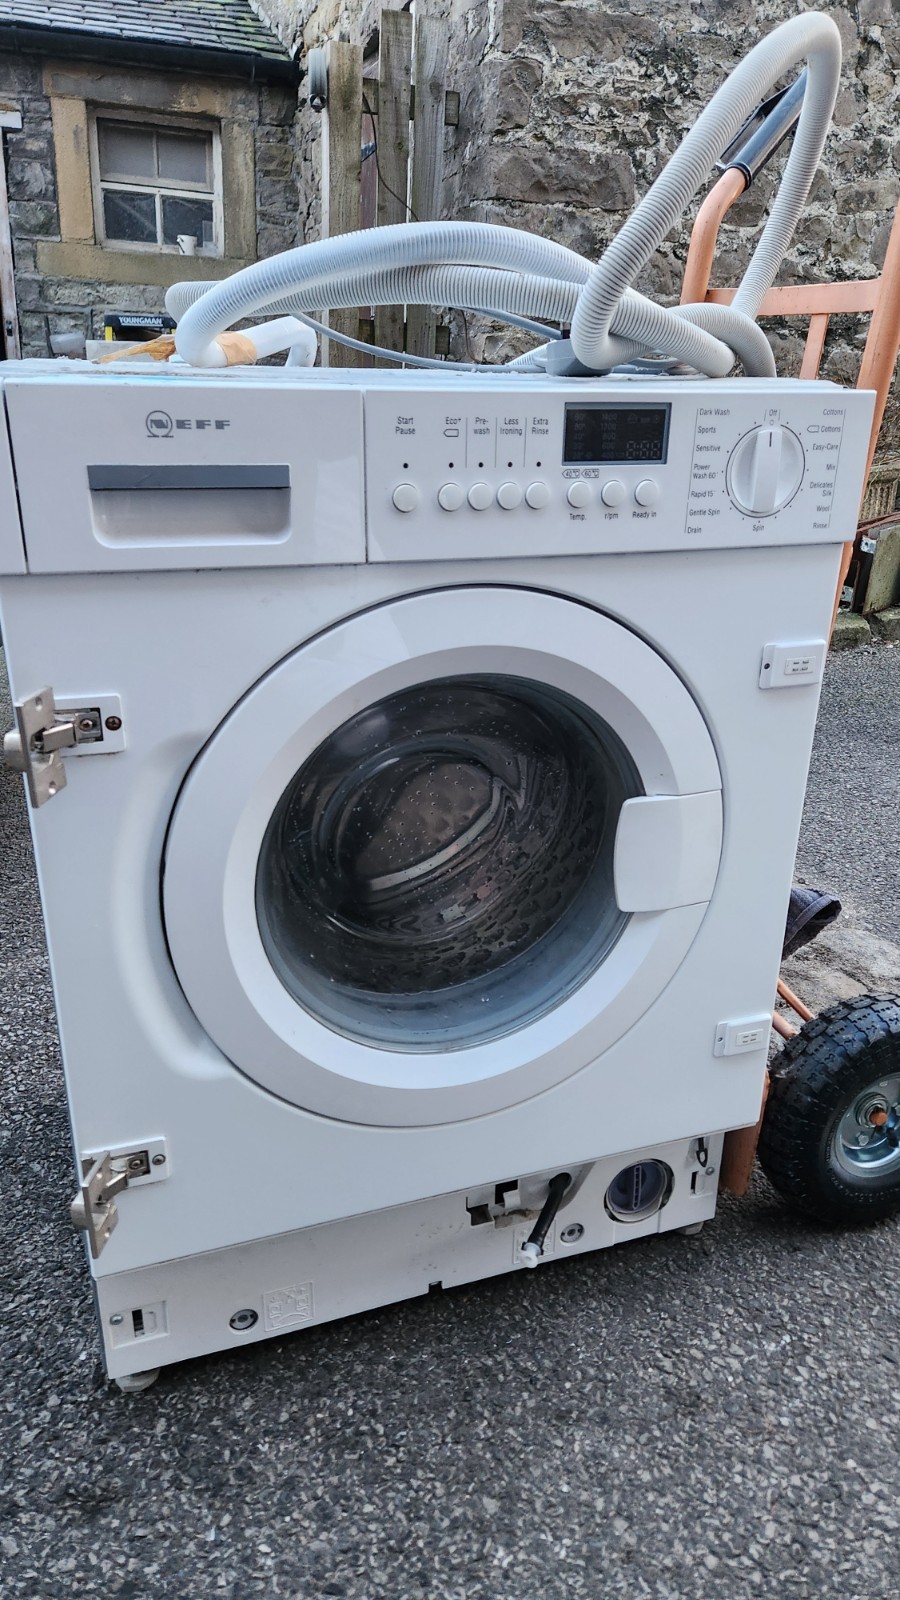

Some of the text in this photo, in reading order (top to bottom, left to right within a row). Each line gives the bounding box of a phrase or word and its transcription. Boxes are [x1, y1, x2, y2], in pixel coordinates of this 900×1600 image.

[118, 316, 163, 325] YOUNGMAN
[699, 408, 731, 416] Dark Wash
[769, 409, 778, 417] Off
[822, 408, 844, 416] Cottons
[397, 416, 414, 425] Start
[475, 416, 489, 425] Pre-
[504, 416, 519, 425] Less
[532, 417, 549, 425] Extra
[395, 426, 416, 435] Pause
[473, 427, 491, 436] wash
[500, 426, 523, 436] Ironing
[531, 426, 549, 436] Rinse
[697, 426, 717, 435] Sports
[820, 425, 841, 433] Cottons
[695, 444, 721, 452] Sensitive
[812, 443, 839, 451] Easy-Care
[693, 463, 711, 471] Power
[809, 481, 833, 489] Delicates
[690, 490, 707, 498] Rapid
[822, 489, 832, 497] Silk
[689, 508, 721, 516] Gentle Spin
[816, 505, 830, 513] Wool
[569, 513, 587, 522] Temp.
[631, 510, 657, 520] Ready in
[687, 526, 702, 534] Drain
[752, 524, 765, 532] Spin
[812, 522, 828, 530] Rinse
